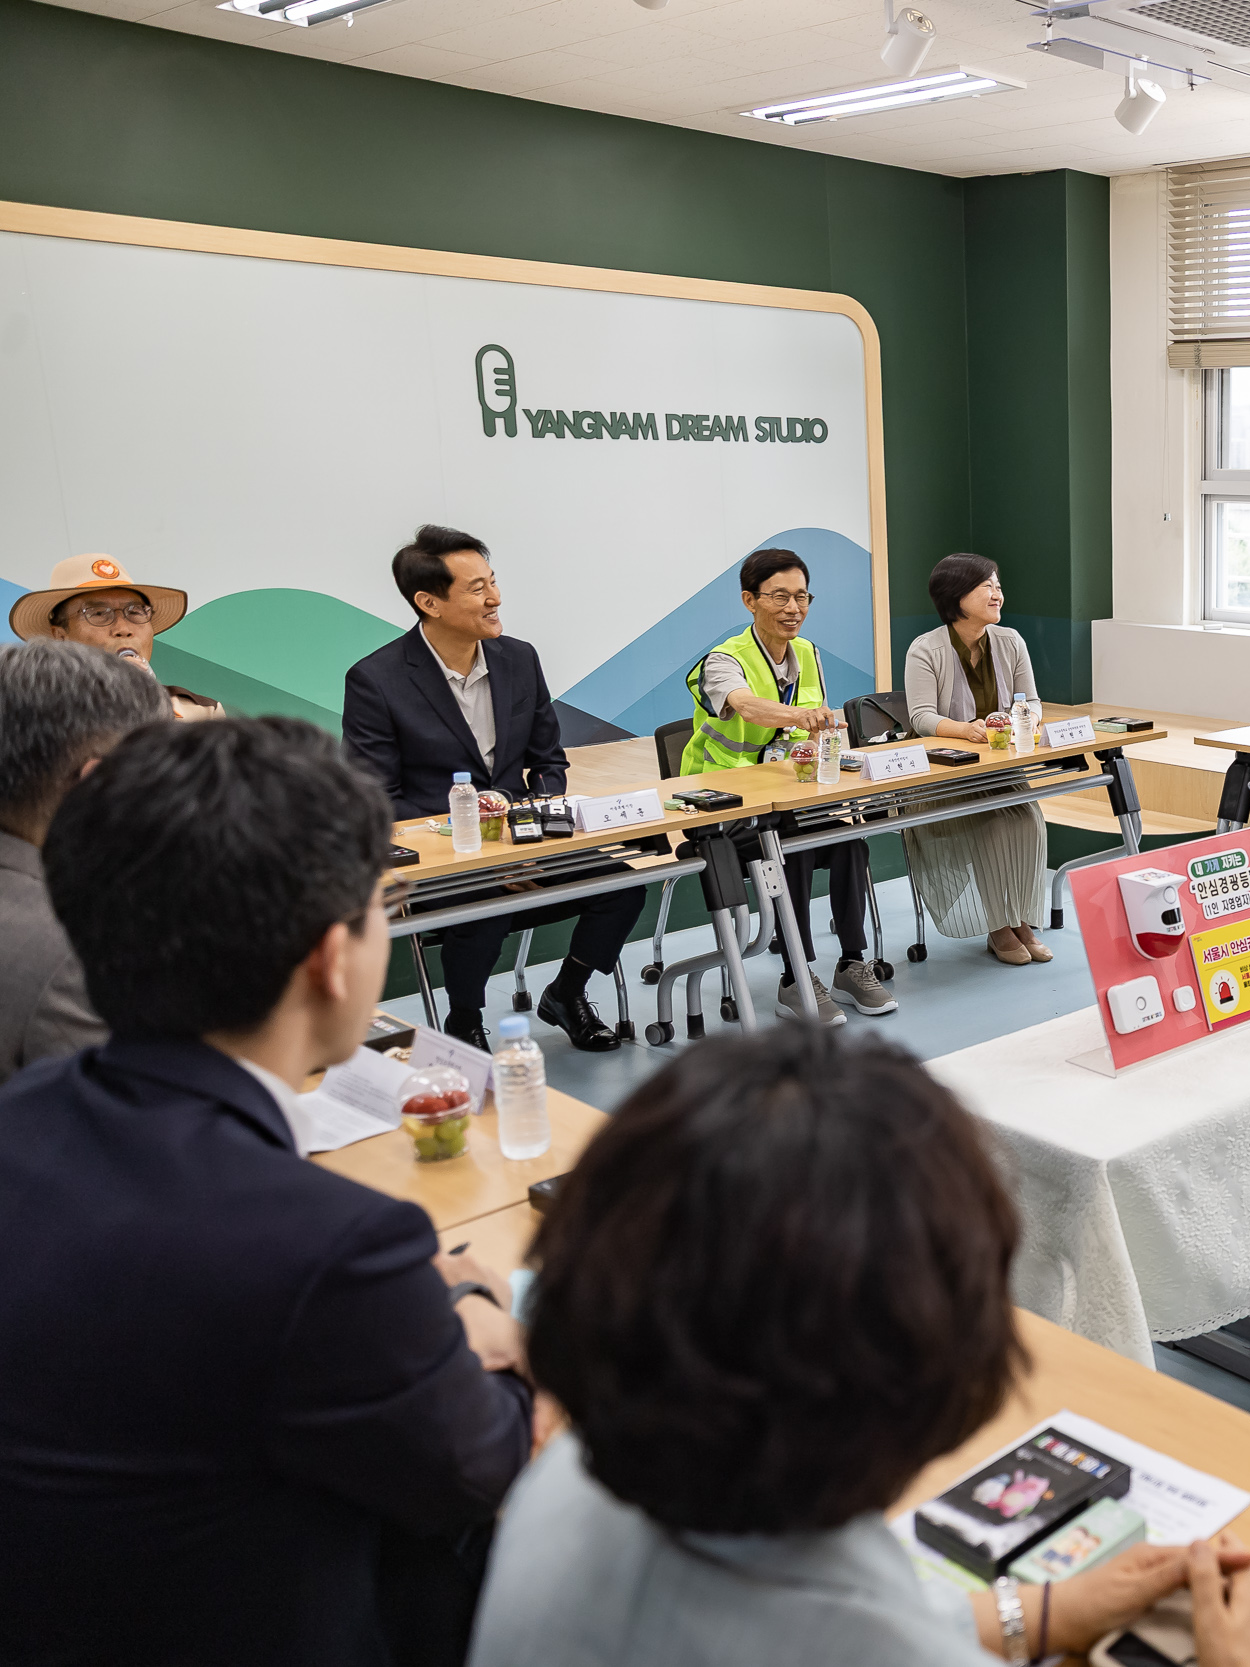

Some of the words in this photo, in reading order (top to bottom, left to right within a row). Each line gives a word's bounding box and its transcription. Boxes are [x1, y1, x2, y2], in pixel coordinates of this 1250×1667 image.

[521, 408, 659, 440] YANGNAM
[665, 413, 749, 442] DREAM
[754, 416, 829, 444] STUDIO
[1194, 862, 1204, 875] 내
[1221, 854, 1243, 868] 지키는
[1203, 943, 1230, 964] 서울시
